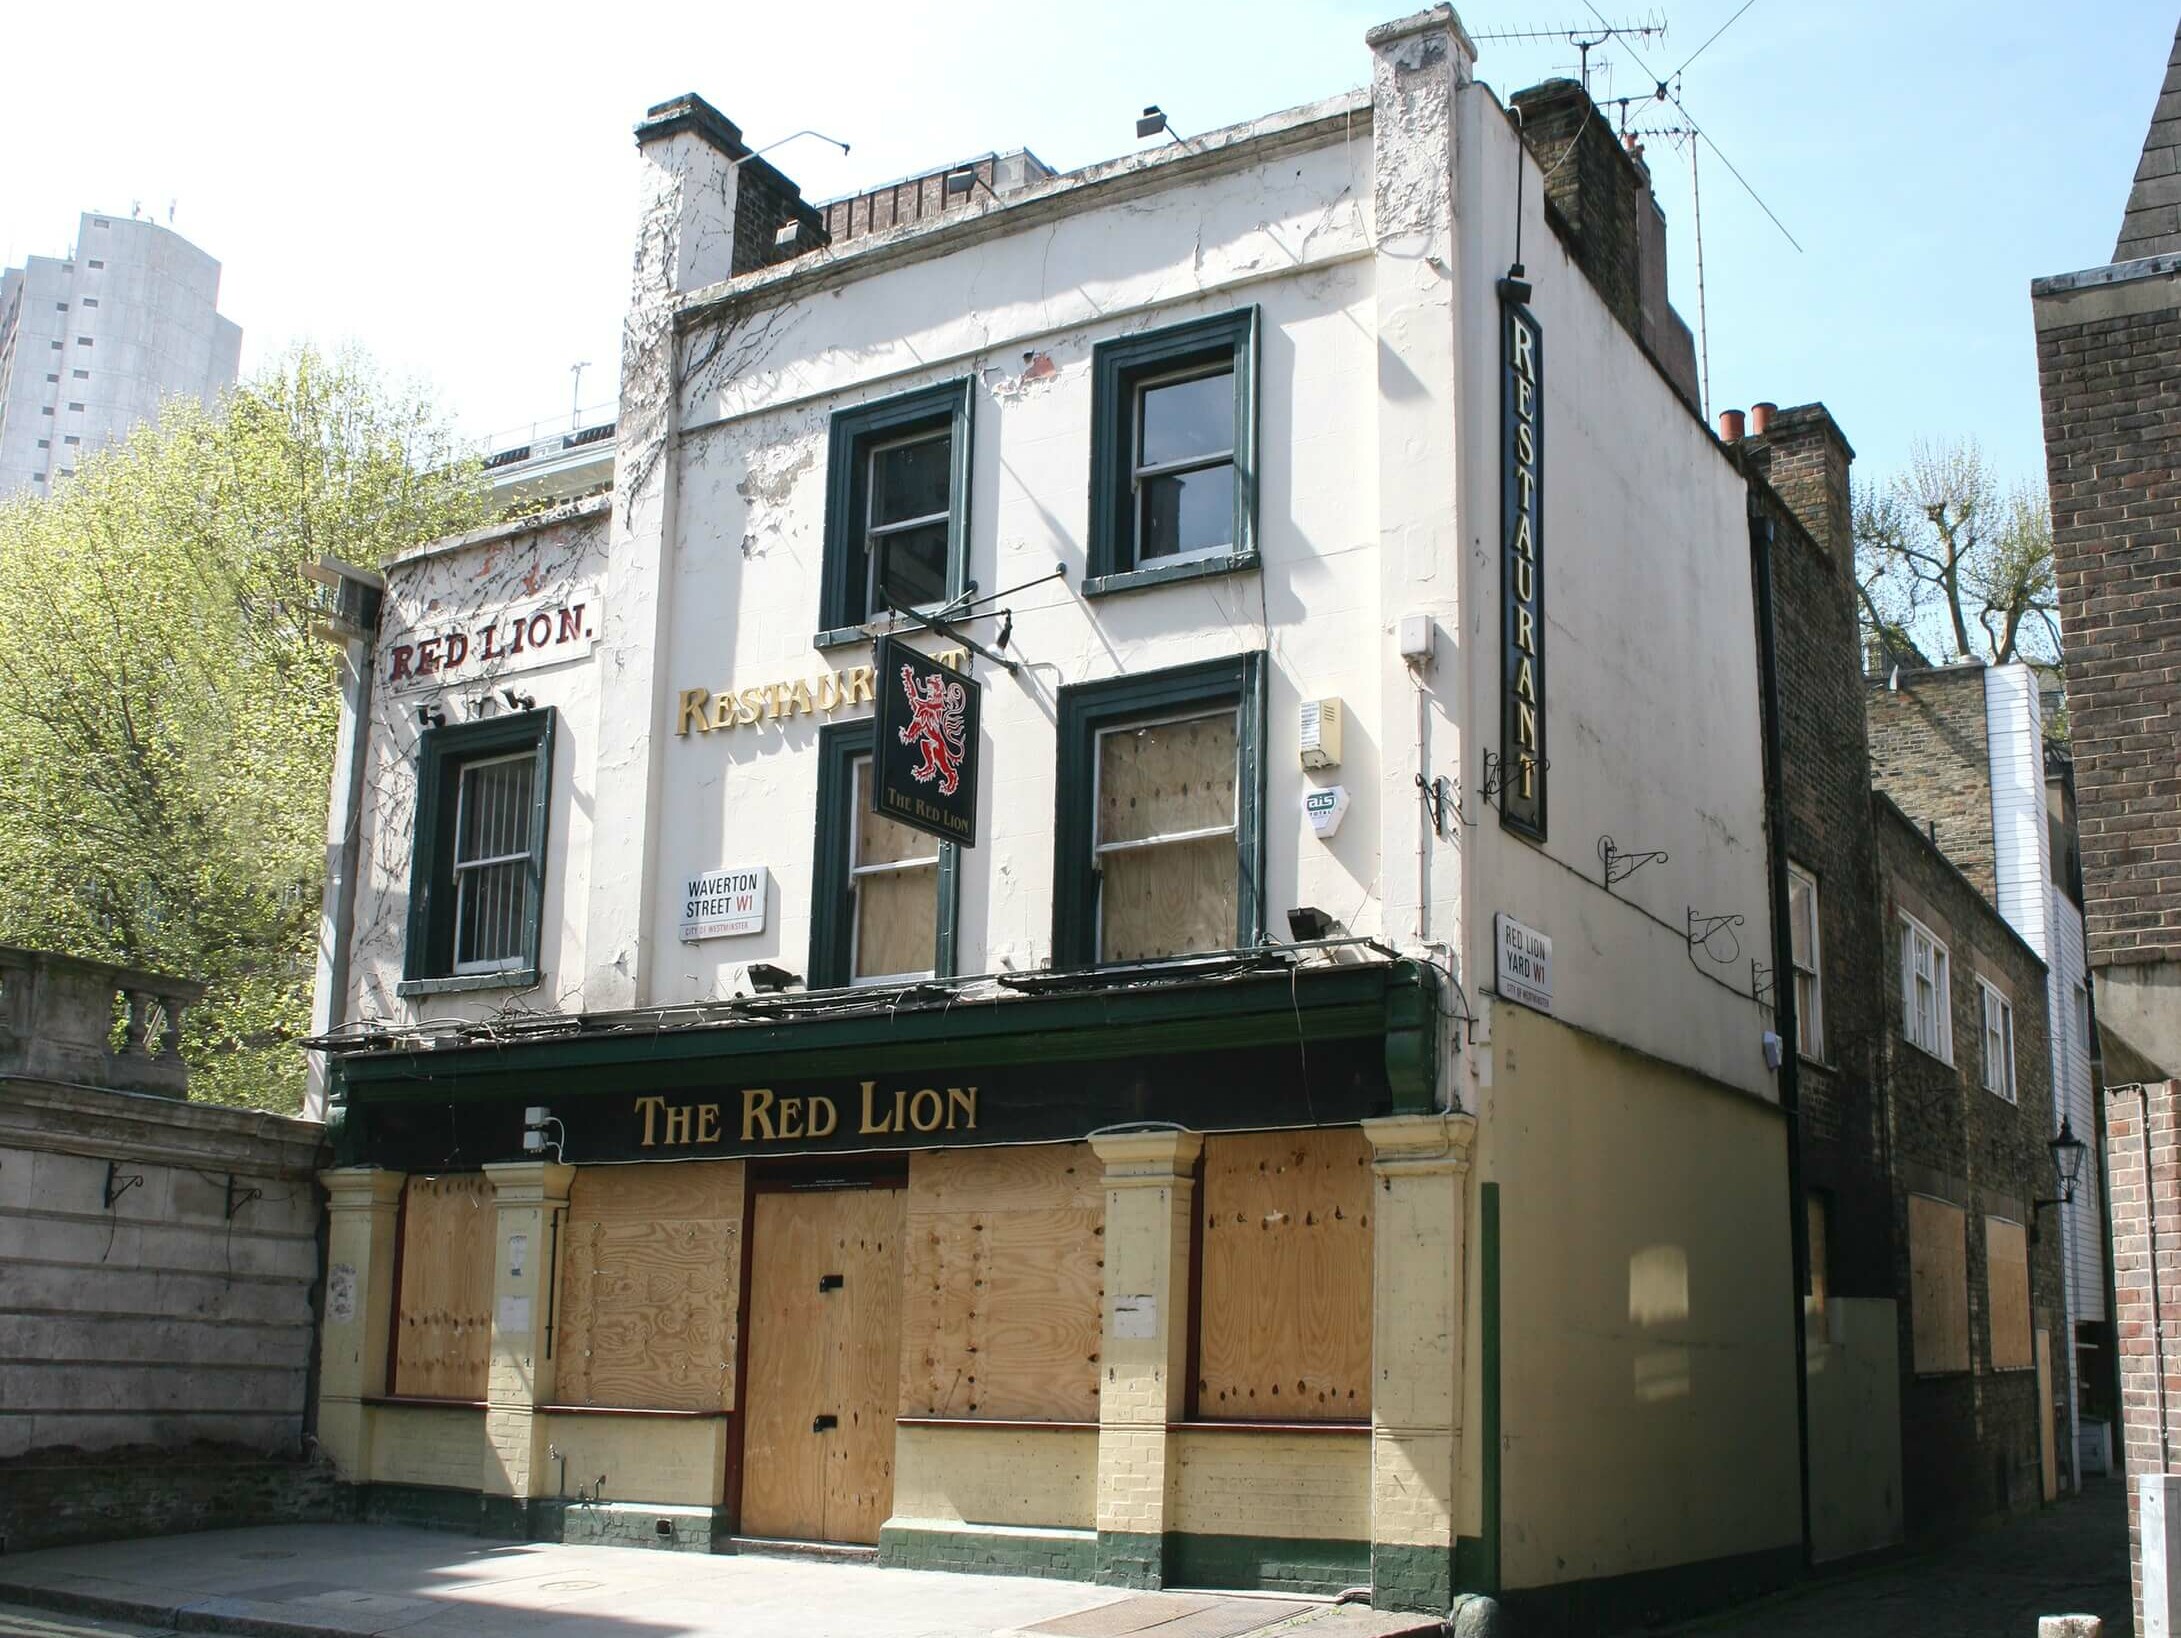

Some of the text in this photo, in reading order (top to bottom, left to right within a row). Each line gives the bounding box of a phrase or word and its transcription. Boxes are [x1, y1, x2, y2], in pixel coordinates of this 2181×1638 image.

[1511, 316, 1536, 799] RESTAURANT
[389, 604, 592, 682] RED LION.
[674, 647, 968, 736] RESTAURT
[888, 787, 969, 832] THE RED LION
[688, 874, 757, 897] WAVERTON
[686, 895, 753, 918] STREET W1
[685, 921, 749, 936] CITY OF WESTMINSTER
[1506, 925, 1545, 960] RED LION
[1507, 949, 1545, 985] YARD W1
[634, 1081, 977, 1146] THE RED LION
